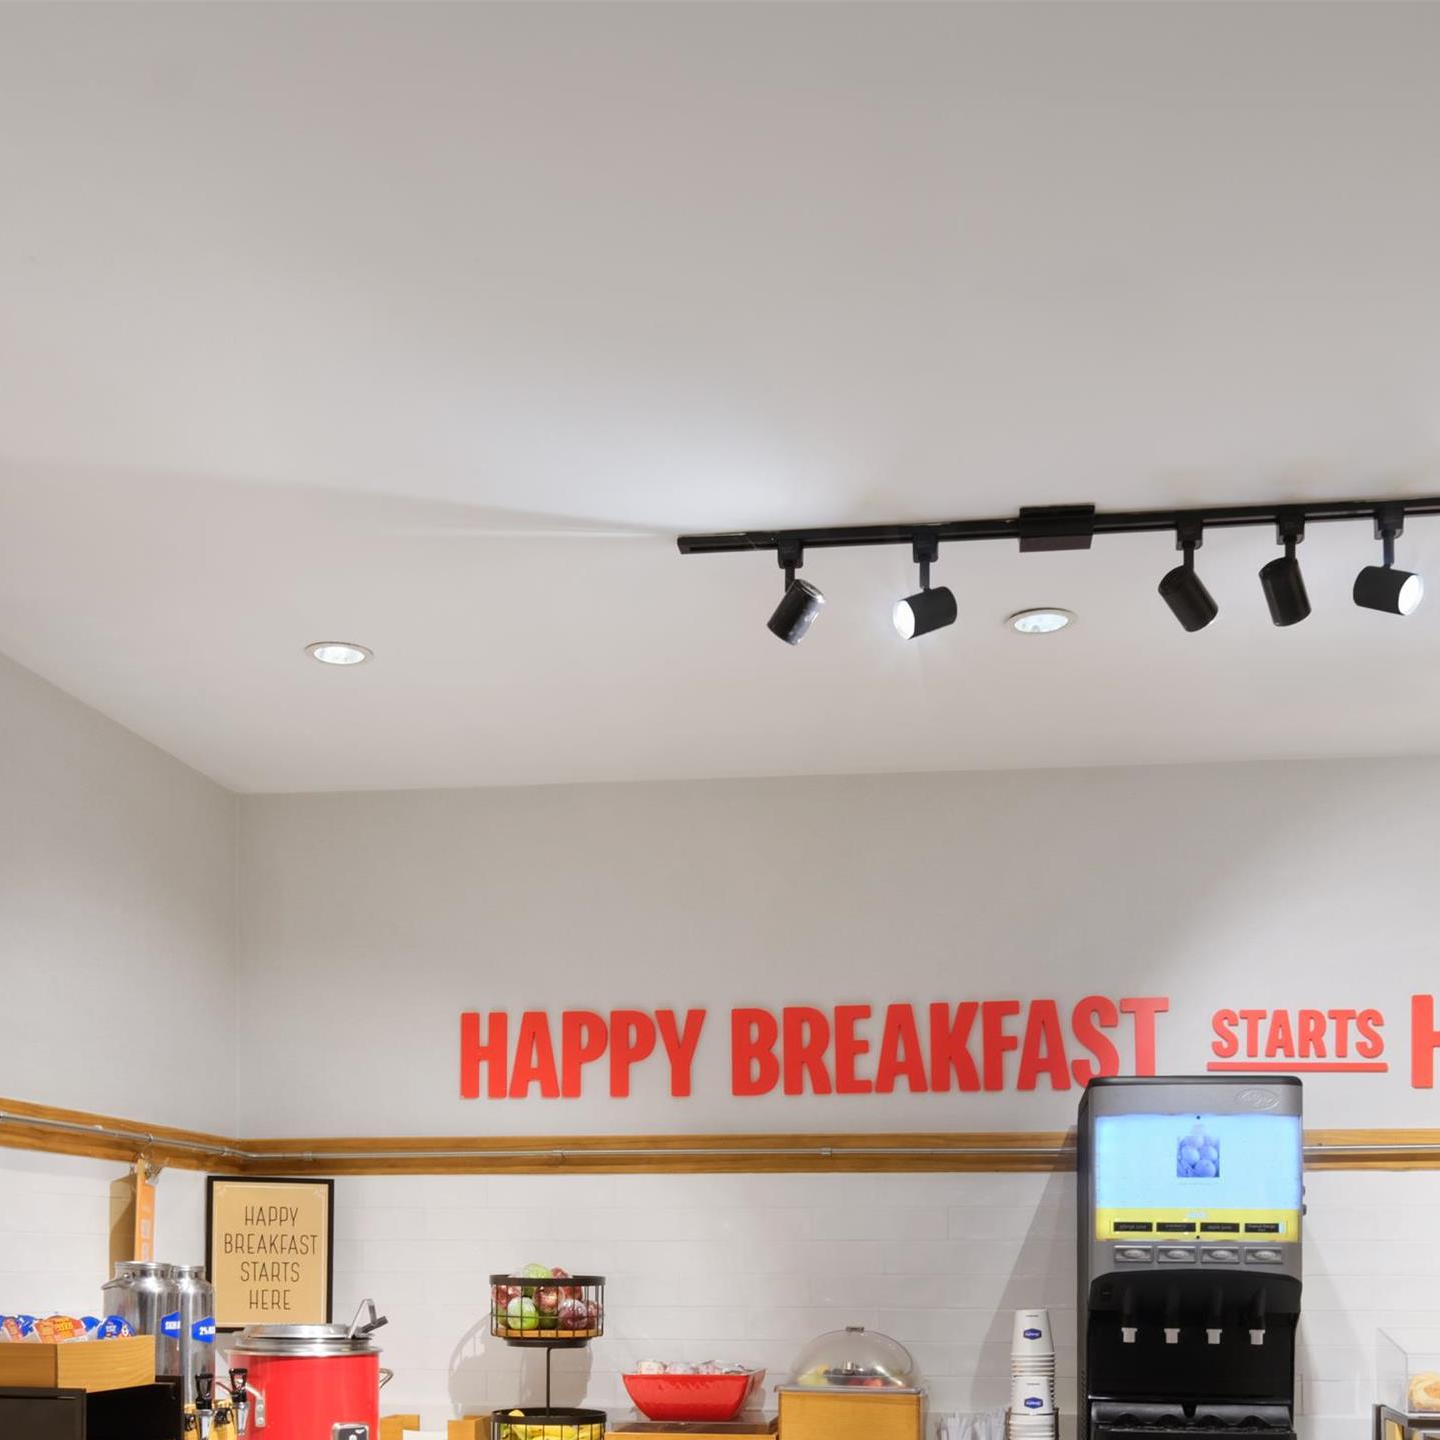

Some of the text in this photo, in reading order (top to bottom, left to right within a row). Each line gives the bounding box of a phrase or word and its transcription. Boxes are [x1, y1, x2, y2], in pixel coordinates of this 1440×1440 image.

[460, 1008, 707, 1099] HAPPY
[730, 994, 1169, 1097] BREAKFAST
[1210, 1008, 1385, 1059] STARTS
[244, 1205, 299, 1227] HAPPY
[223, 1232, 319, 1256] BREAKFAST
[239, 1260, 301, 1283] STARTS
[248, 1288, 292, 1311] HERE
